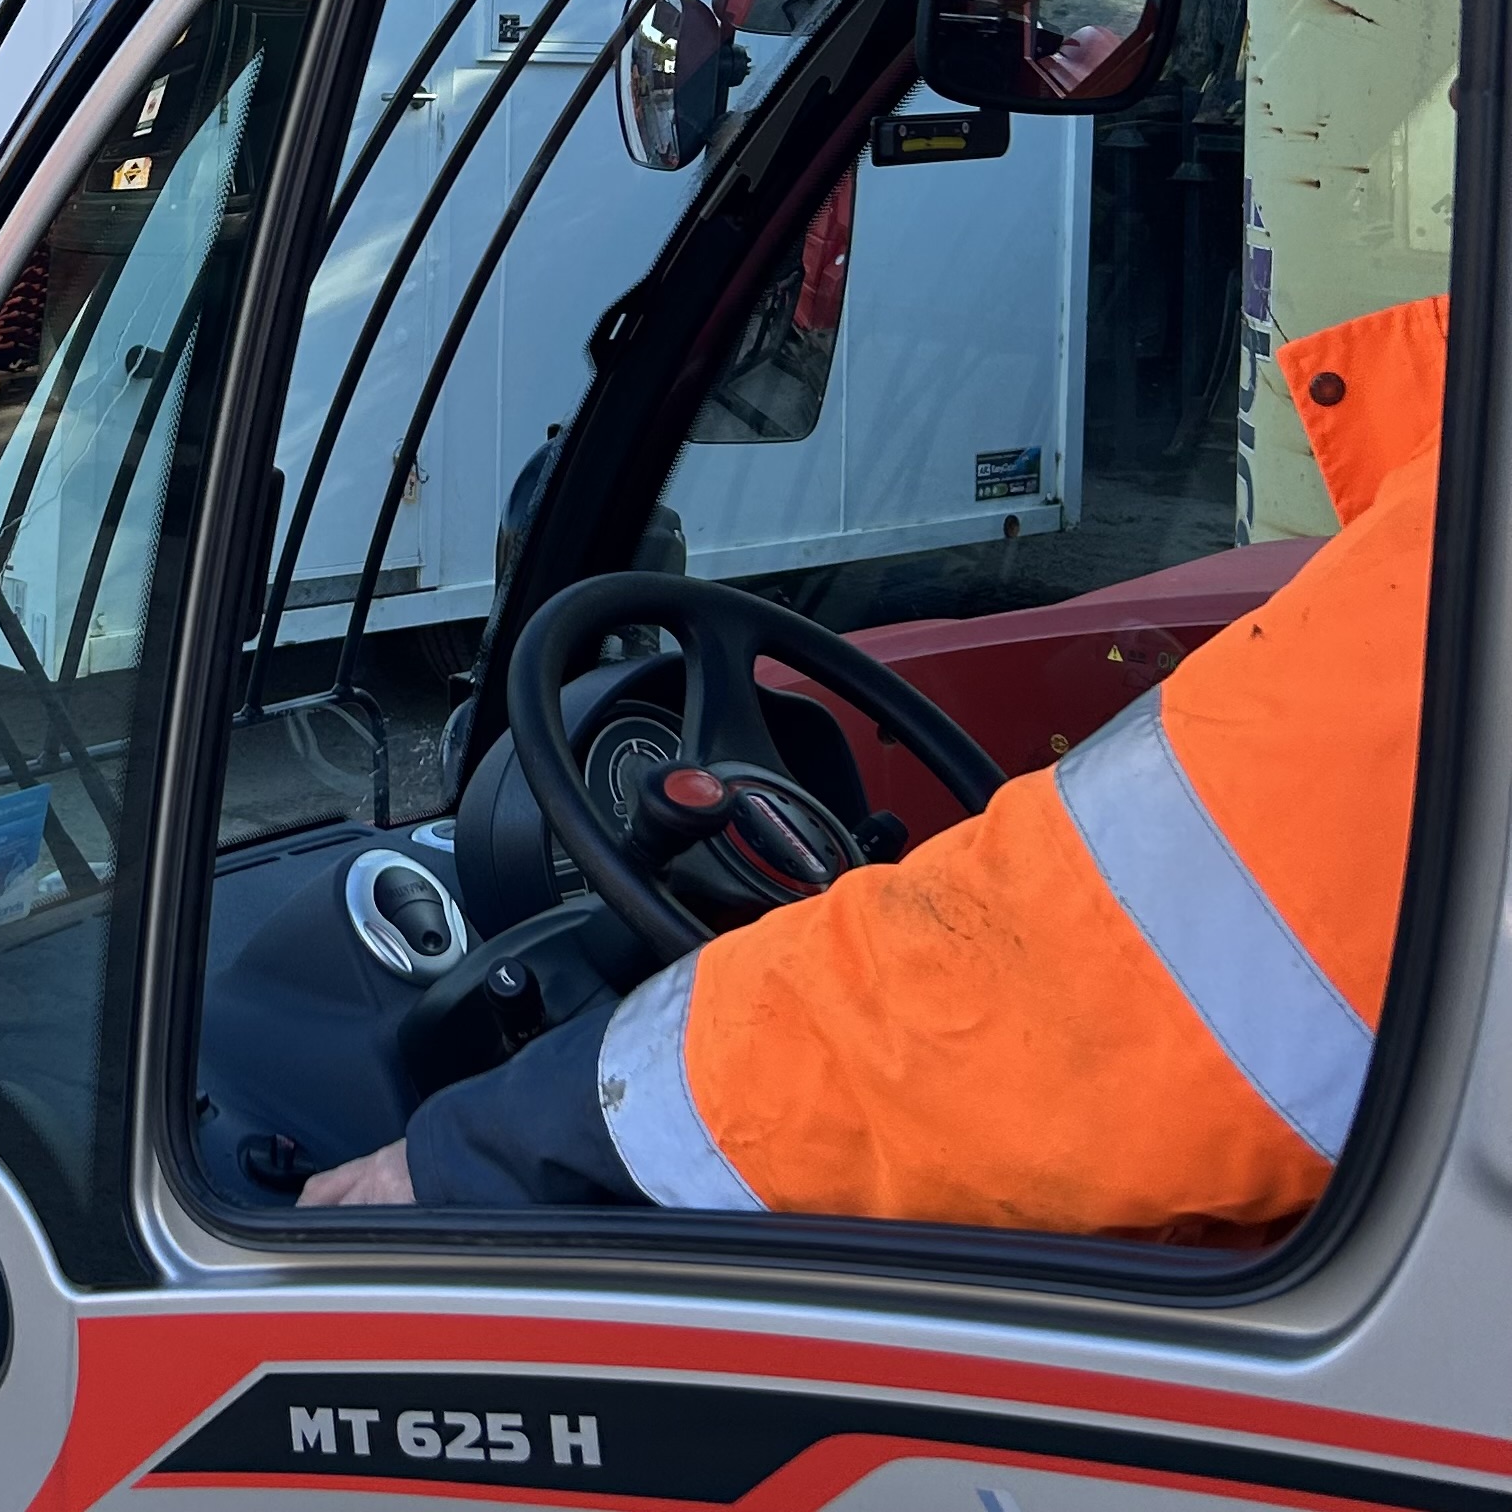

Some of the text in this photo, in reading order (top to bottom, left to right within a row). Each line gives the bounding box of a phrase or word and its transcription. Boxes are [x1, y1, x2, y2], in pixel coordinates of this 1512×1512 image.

[289, 1405, 602, 1467] MT 625 H
